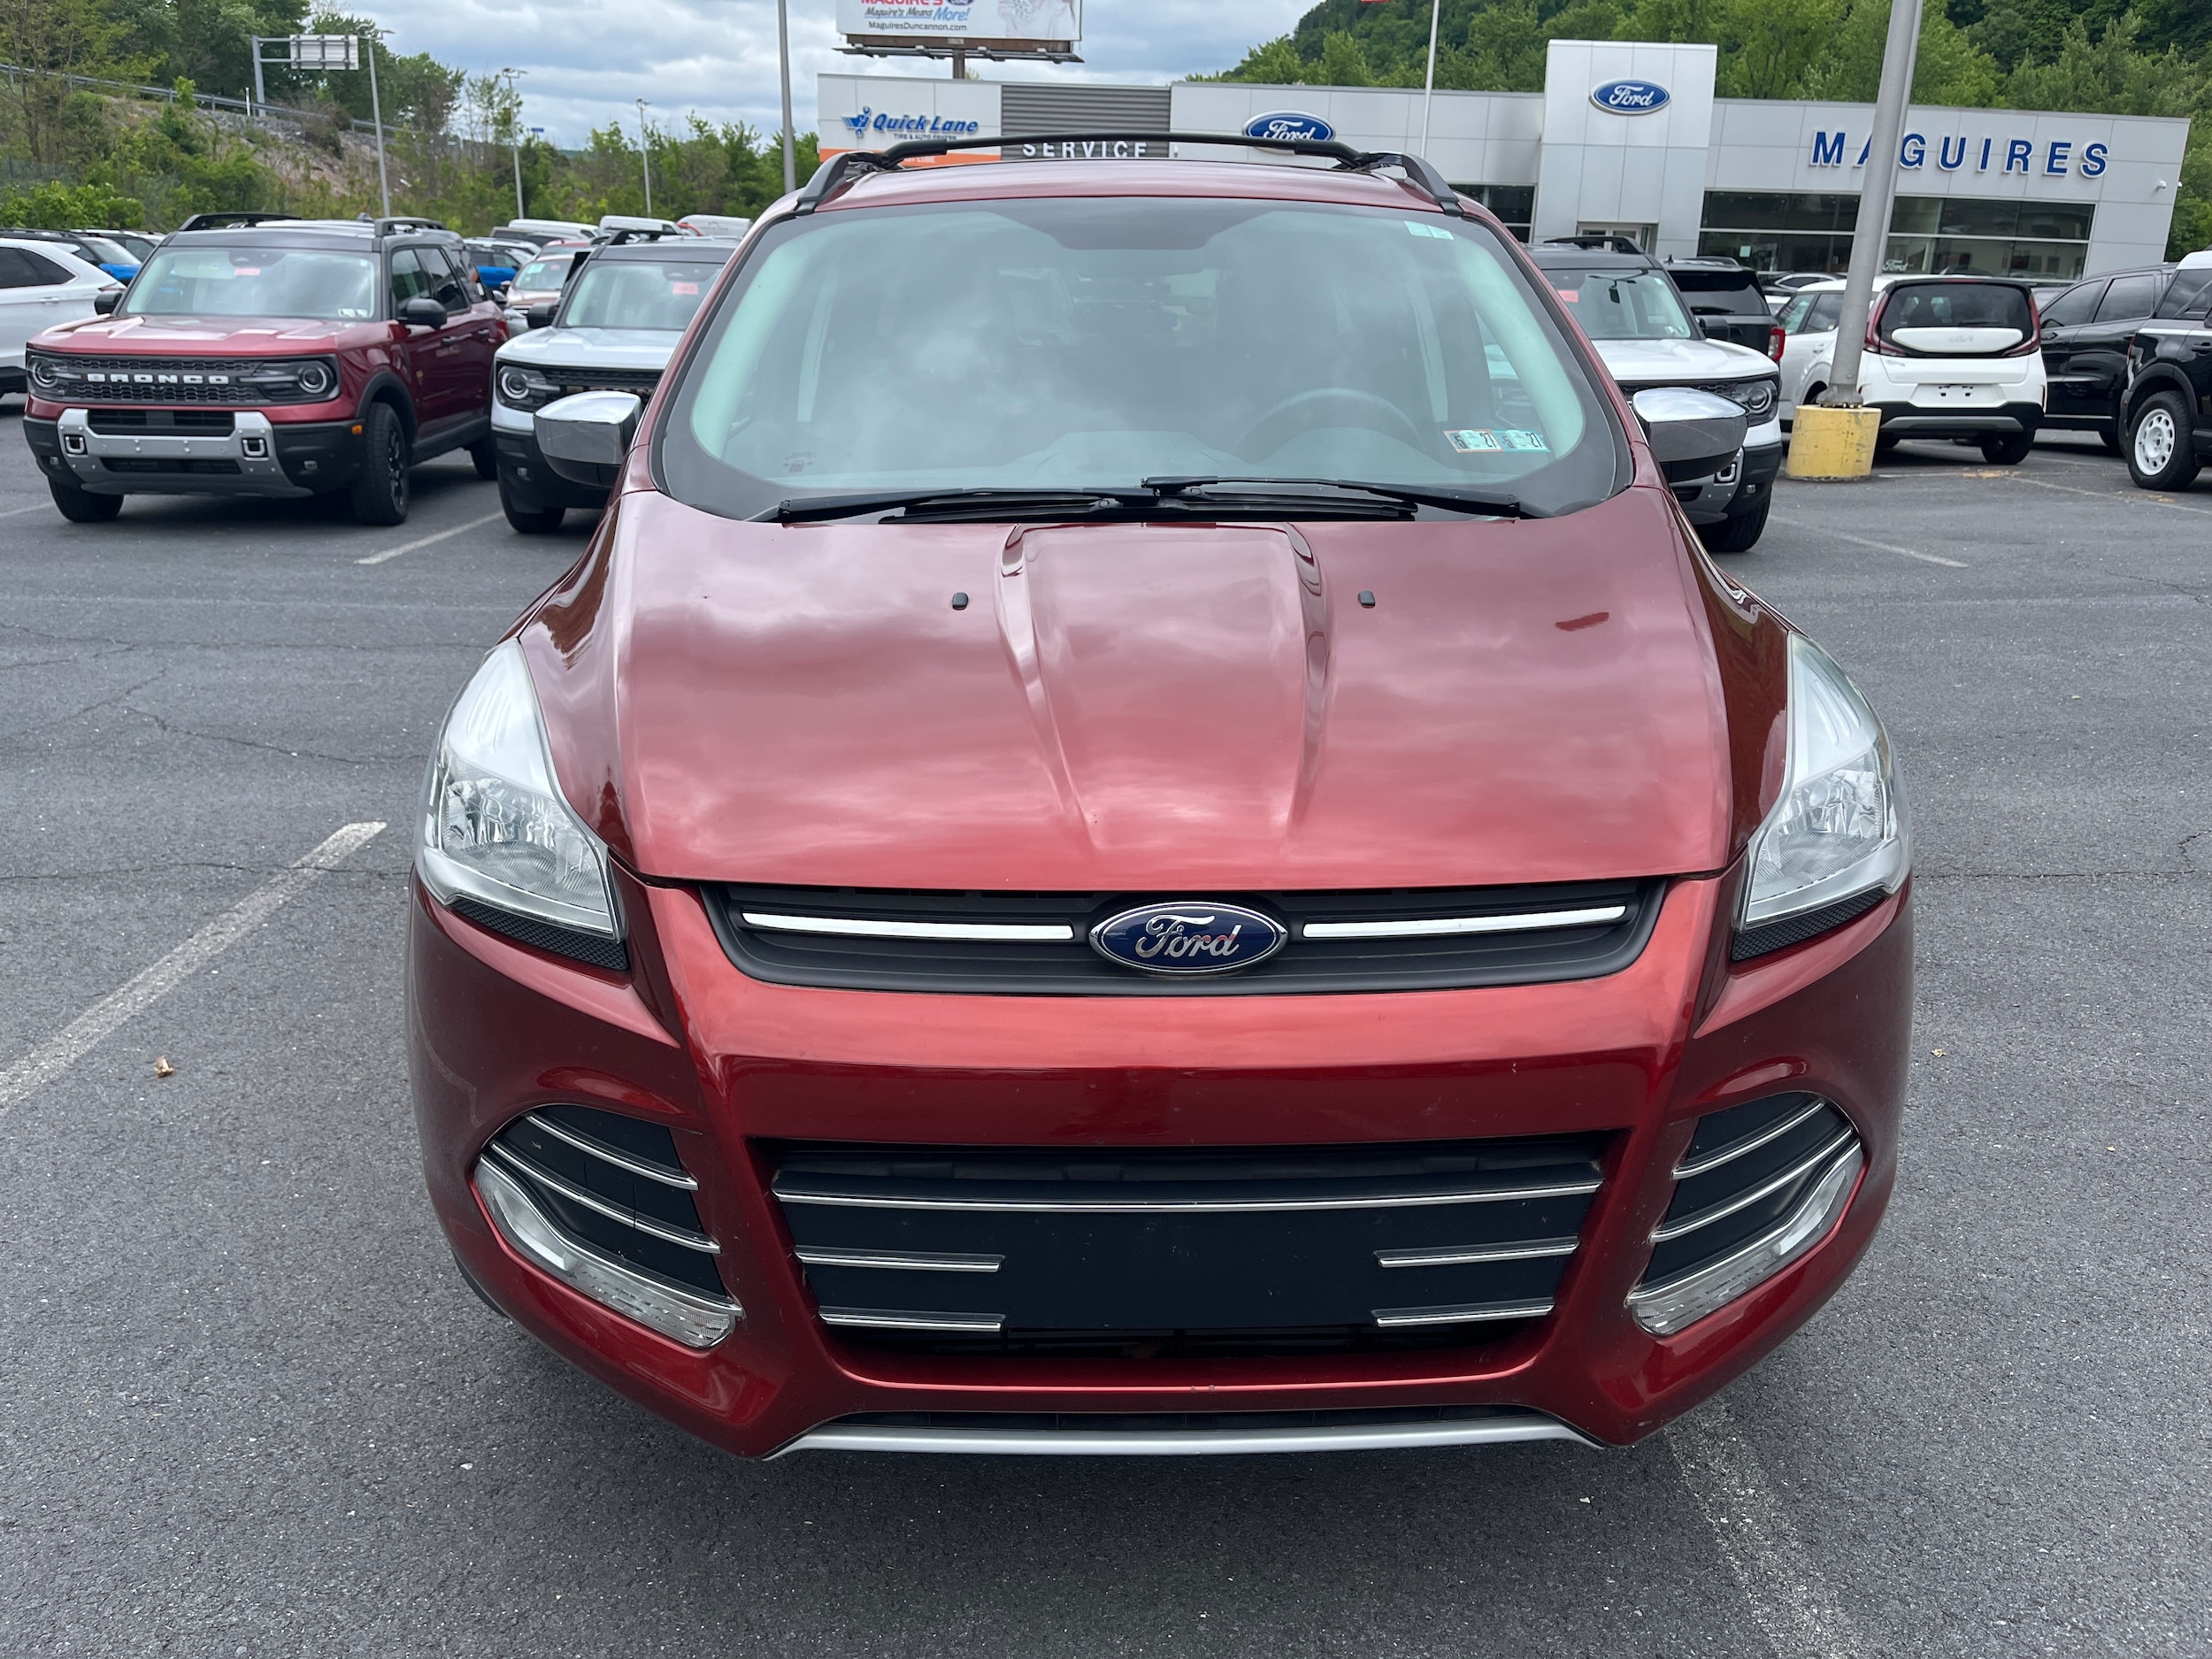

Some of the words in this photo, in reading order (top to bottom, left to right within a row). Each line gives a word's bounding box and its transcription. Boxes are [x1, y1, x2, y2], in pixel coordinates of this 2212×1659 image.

[906, 7, 933, 16] Means
[933, 7, 971, 20] More!
[868, 21, 967, 31] MaguiresDuncannon.com
[1609, 85, 1655, 106] Ford
[873, 113, 927, 131] Quick
[930, 116, 979, 133] Lane
[1022, 142, 1148, 158] SERVICE
[88, 373, 229, 384] BRONCO
[1479, 432, 1497, 449] 27
[1525, 433, 1542, 448] 27
[1135, 914, 1242, 958] Ford
